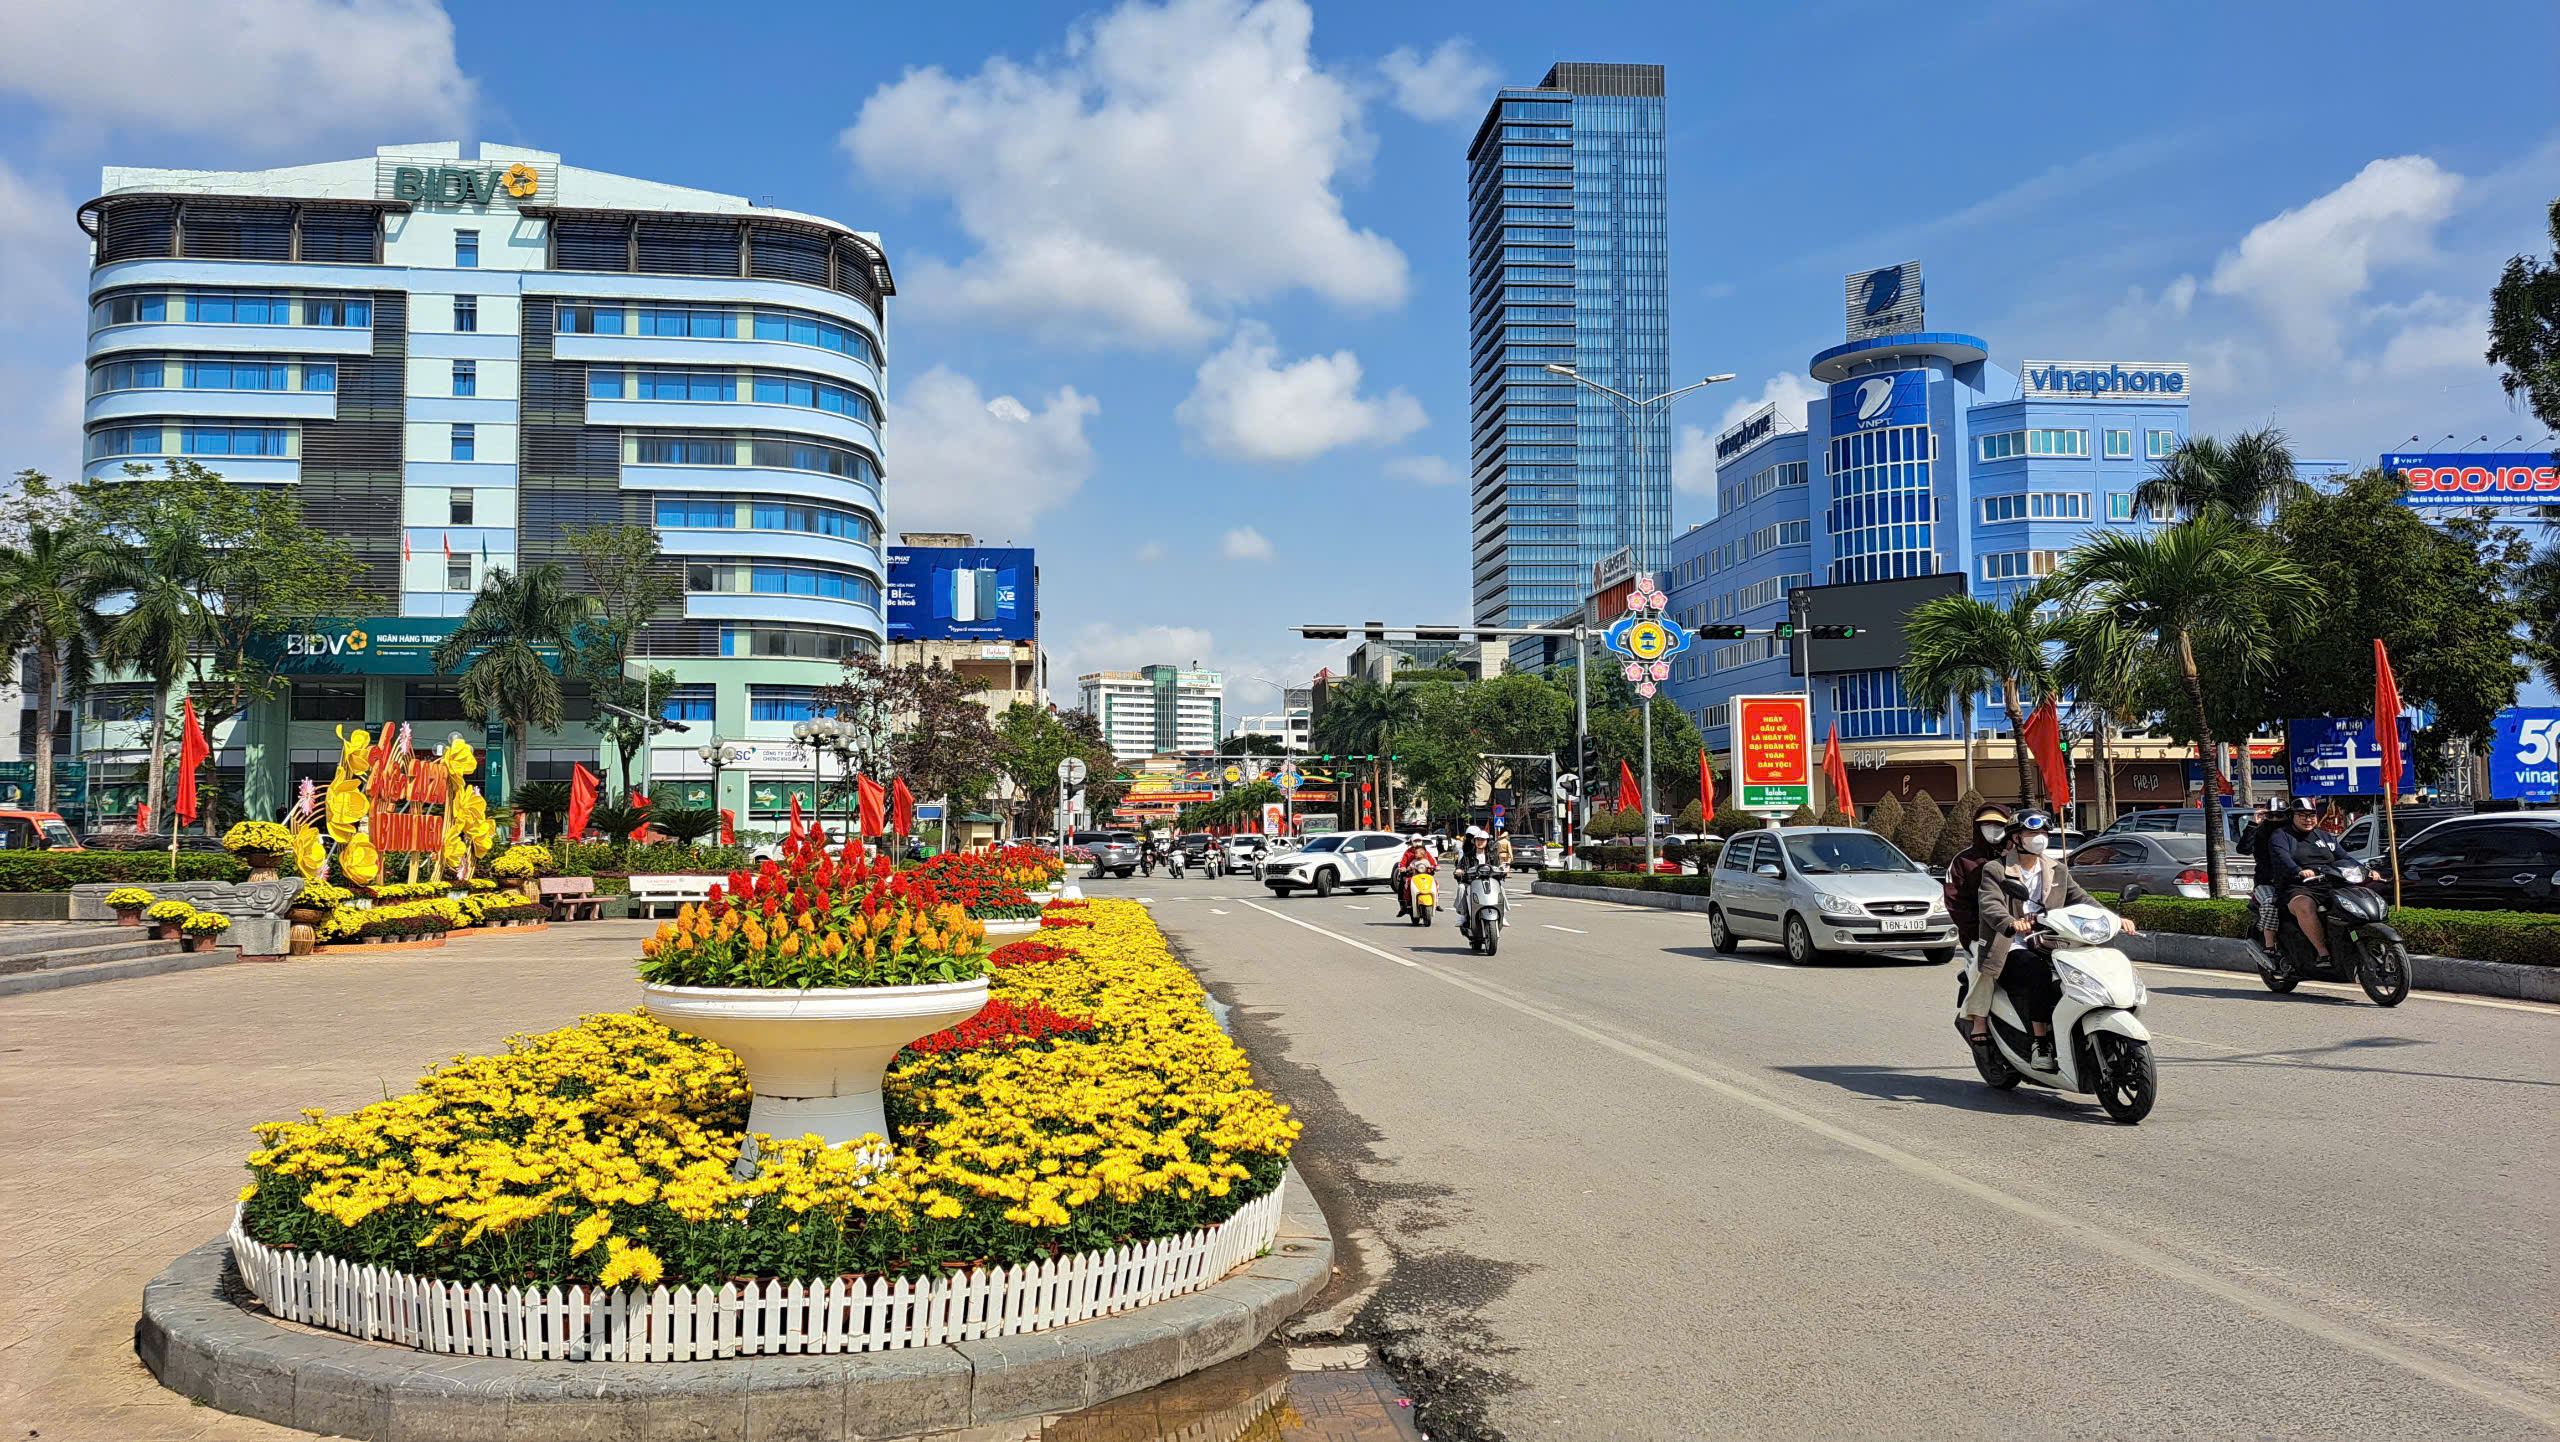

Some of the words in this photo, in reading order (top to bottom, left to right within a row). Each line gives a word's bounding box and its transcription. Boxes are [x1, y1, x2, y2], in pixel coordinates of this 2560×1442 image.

[395, 167, 503, 204] BIDV
[2030, 365, 2184, 396] vinaphone
[1716, 415, 1770, 459] vinaphone
[1857, 418, 1893, 429] VNPT
